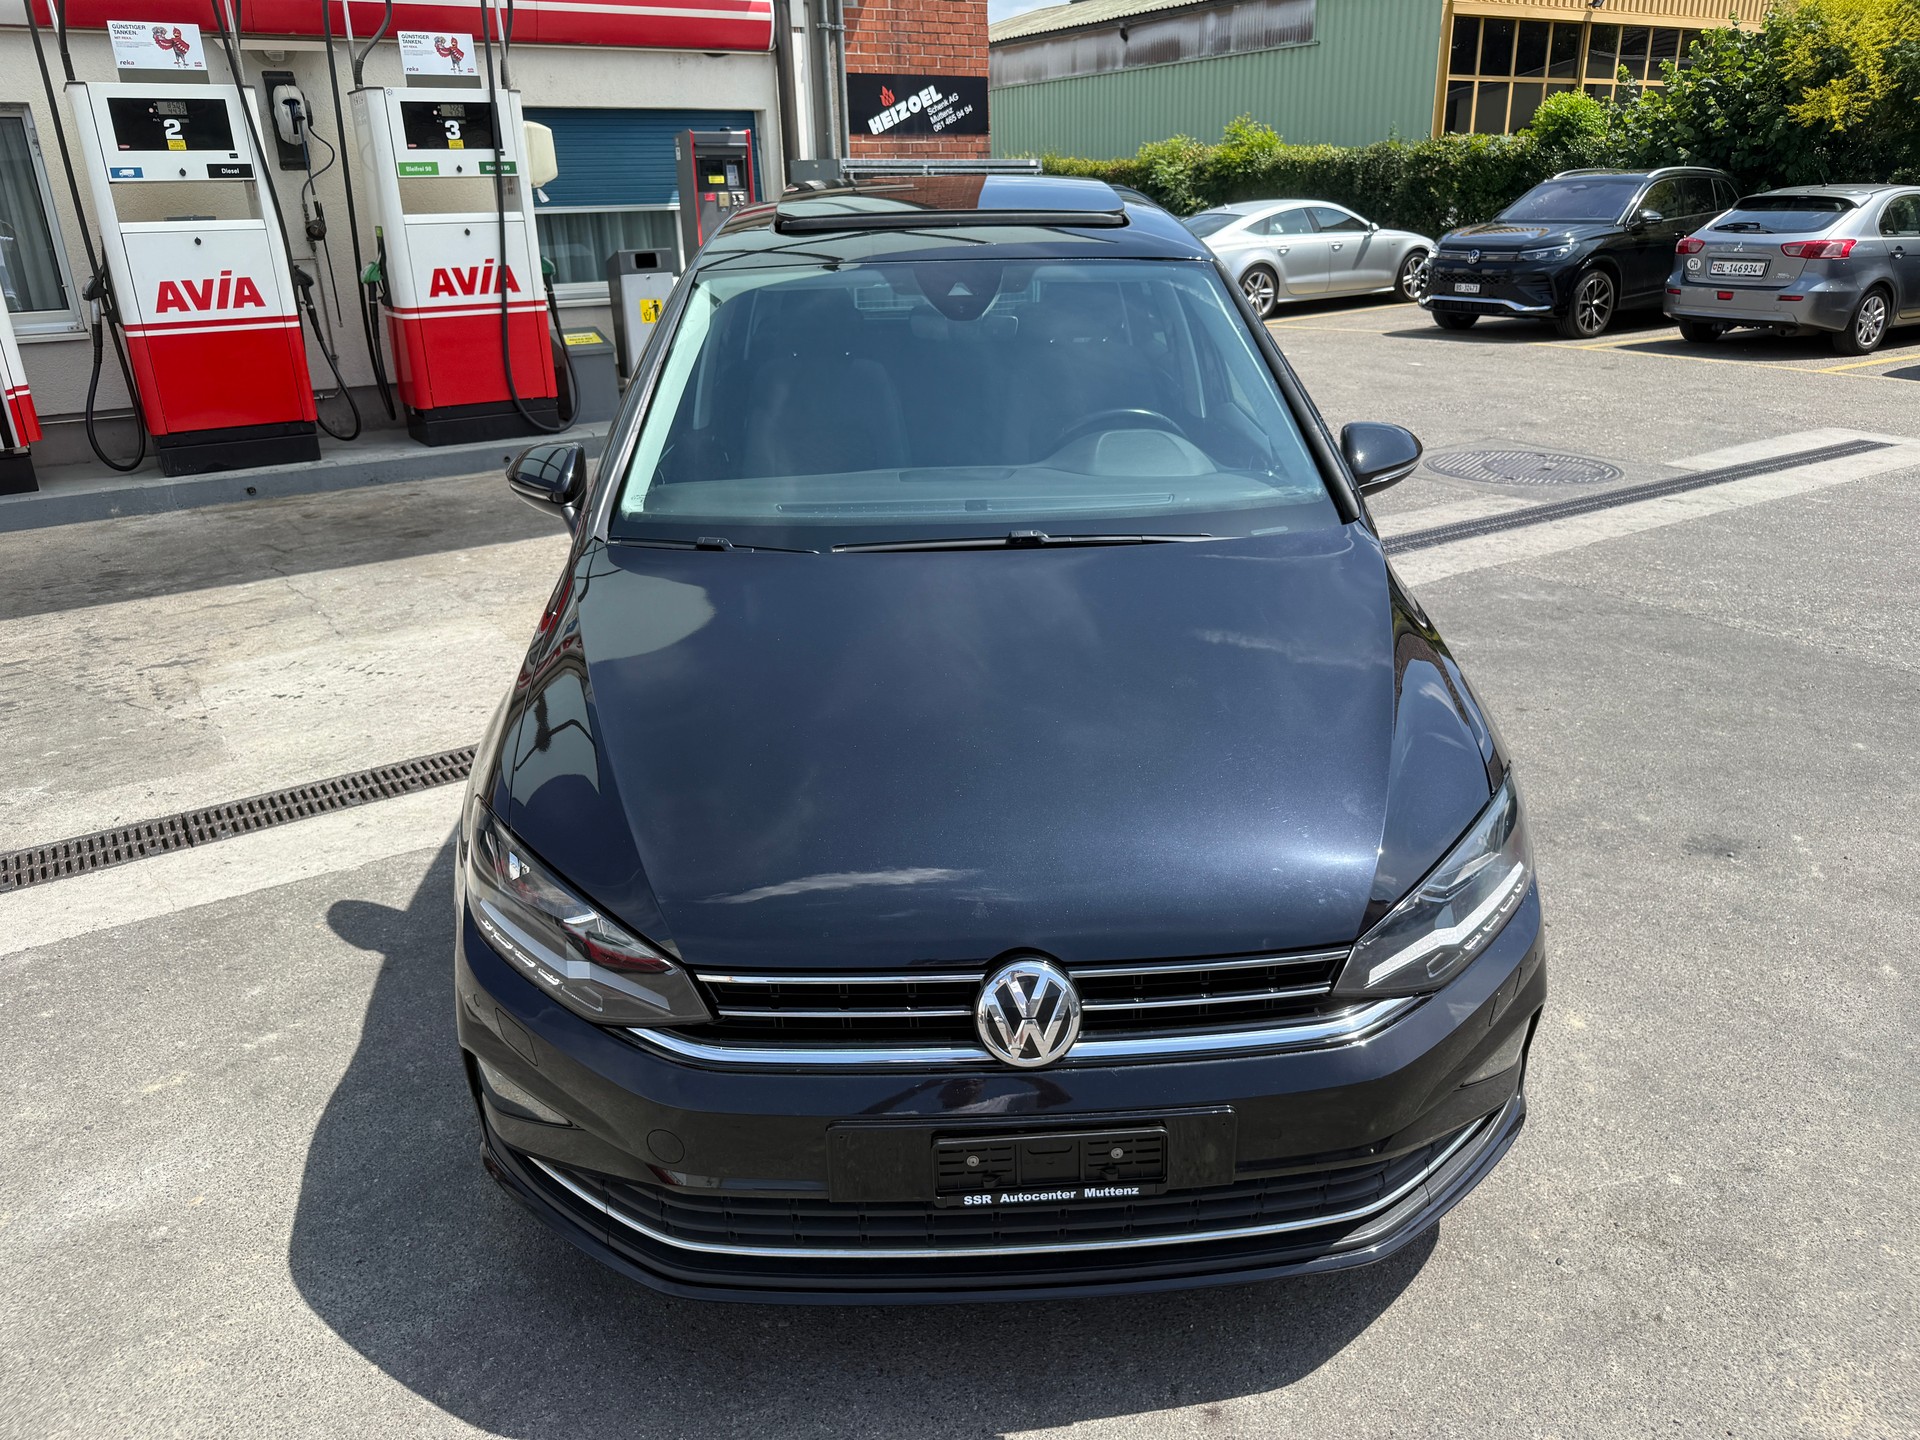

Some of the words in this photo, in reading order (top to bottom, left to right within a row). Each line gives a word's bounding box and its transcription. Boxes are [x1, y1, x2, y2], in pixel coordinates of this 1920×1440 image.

[948, 92, 959, 104] AG
[868, 85, 943, 135] HEIZOEL
[164, 118, 184, 140] 2
[445, 120, 461, 140] 3
[932, 120, 945, 132] 061
[1690, 259, 1698, 269] CH
[156, 270, 266, 314] AVIA
[964, 1194, 992, 1206] SSR
[1000, 1189, 1076, 1204] Autocenter
[1084, 1186, 1140, 1198] Muttenz
